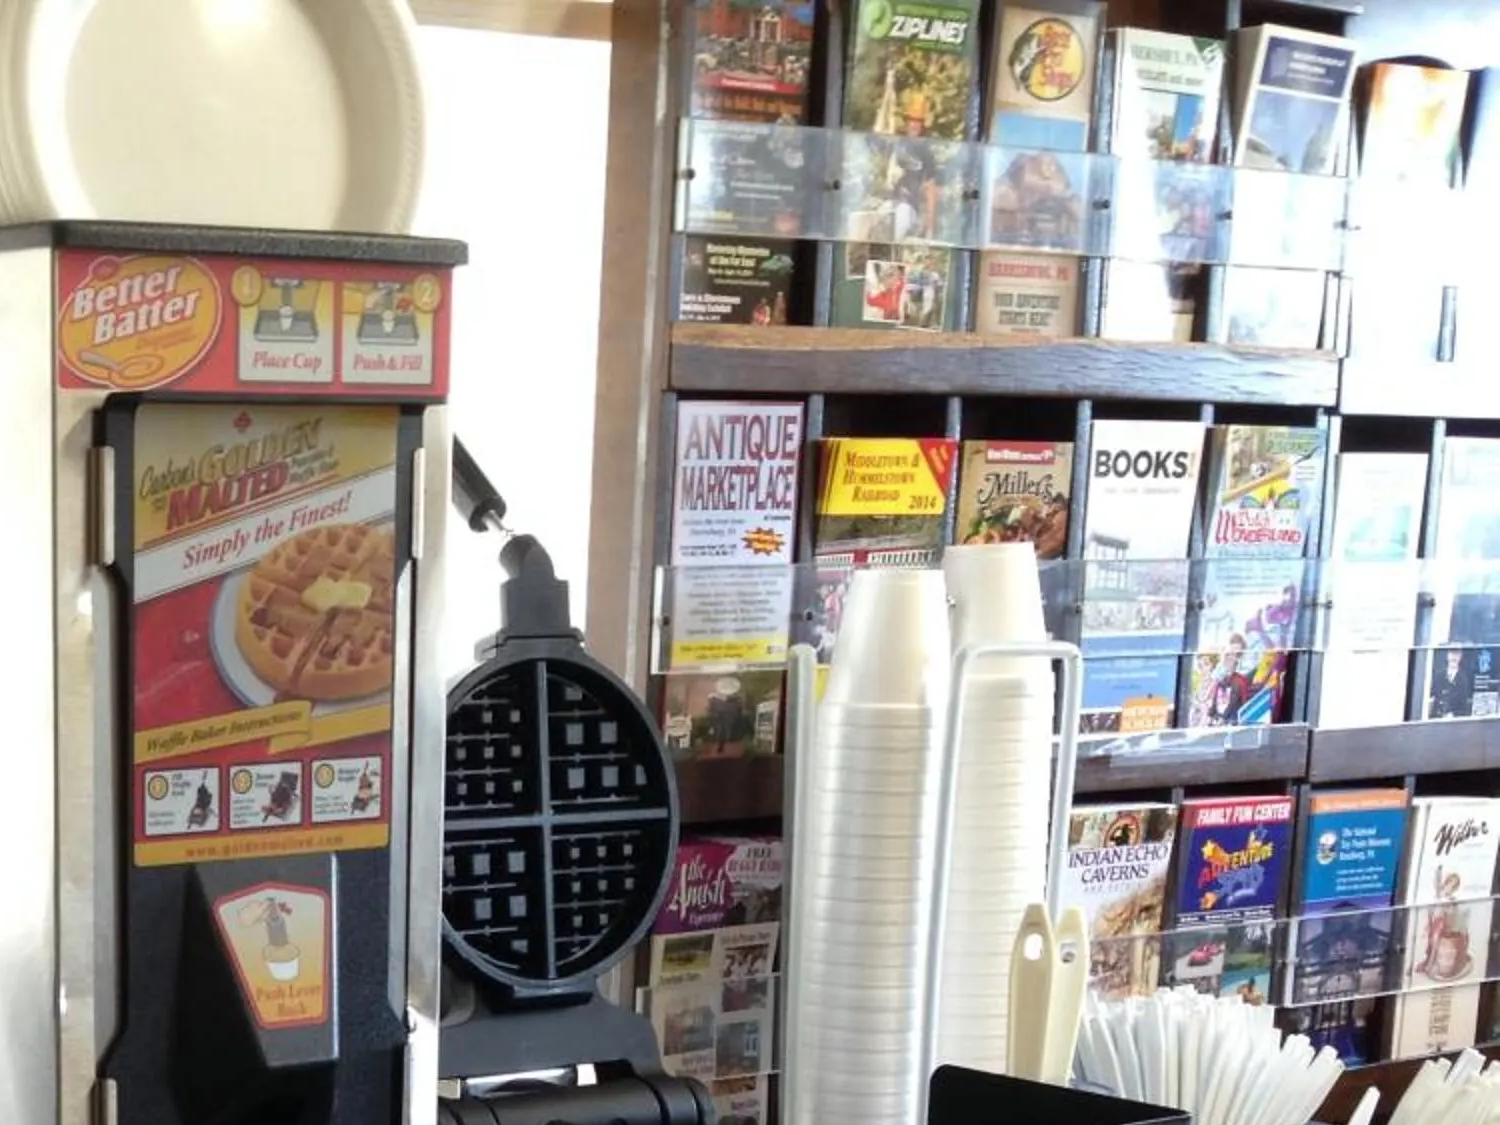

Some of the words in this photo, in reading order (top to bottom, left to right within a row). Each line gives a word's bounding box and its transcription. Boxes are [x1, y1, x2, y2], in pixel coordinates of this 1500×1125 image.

[889, 16, 968, 44] ZIPLINES
[71, 264, 182, 321] Better
[93, 290, 201, 345] Batter
[251, 351, 290, 369] Place
[292, 352, 323, 374] Cup
[353, 354, 384, 371] Push
[397, 354, 422, 371] Fill
[684, 415, 797, 462] ANTIQUE
[166, 461, 290, 532] MALTED
[680, 465, 794, 511] MARKETPLACE
[908, 495, 937, 510] 2014
[183, 530, 250, 570] Simply
[254, 517, 285, 543] the
[288, 490, 352, 533] Finest!
[147, 731, 190, 750] Waffle
[190, 725, 228, 744] Baker
[1198, 806, 1232, 826] FAMILY
[1233, 805, 1253, 824] FUN
[1254, 802, 1291, 821] CENTER
[688, 853, 707, 881] the
[1068, 847, 1126, 869] INDIAN
[1127, 845, 1169, 865] ECHO
[1081, 863, 1150, 885] CAVERNS
[665, 863, 726, 920] Amish
[256, 983, 285, 1001] Push
